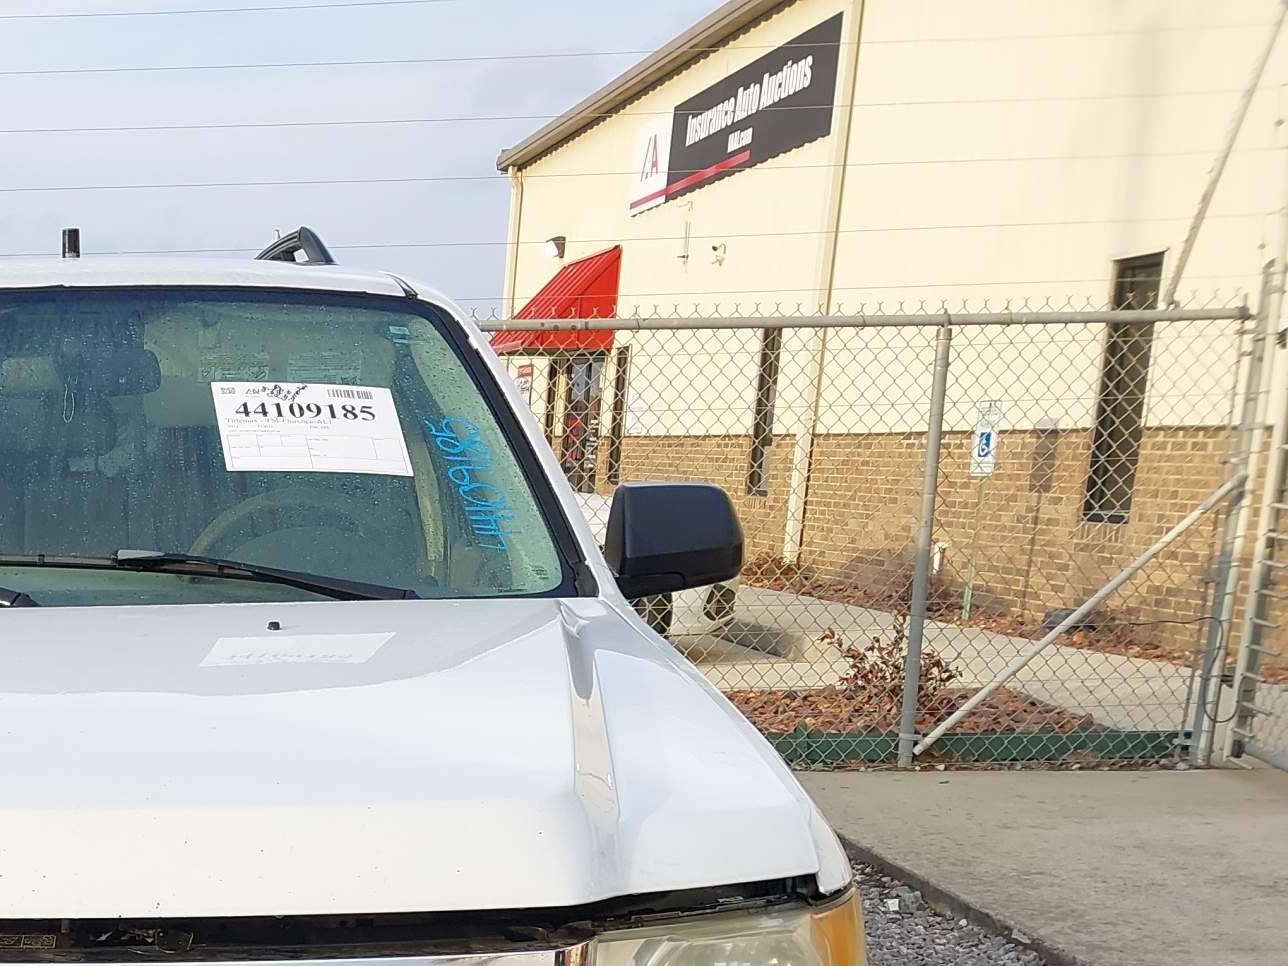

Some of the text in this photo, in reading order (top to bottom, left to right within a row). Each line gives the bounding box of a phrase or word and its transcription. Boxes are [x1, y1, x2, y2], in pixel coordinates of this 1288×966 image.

[685, 55, 814, 147] Insurance Auto Auctions
[235, 401, 376, 422] 44109185
